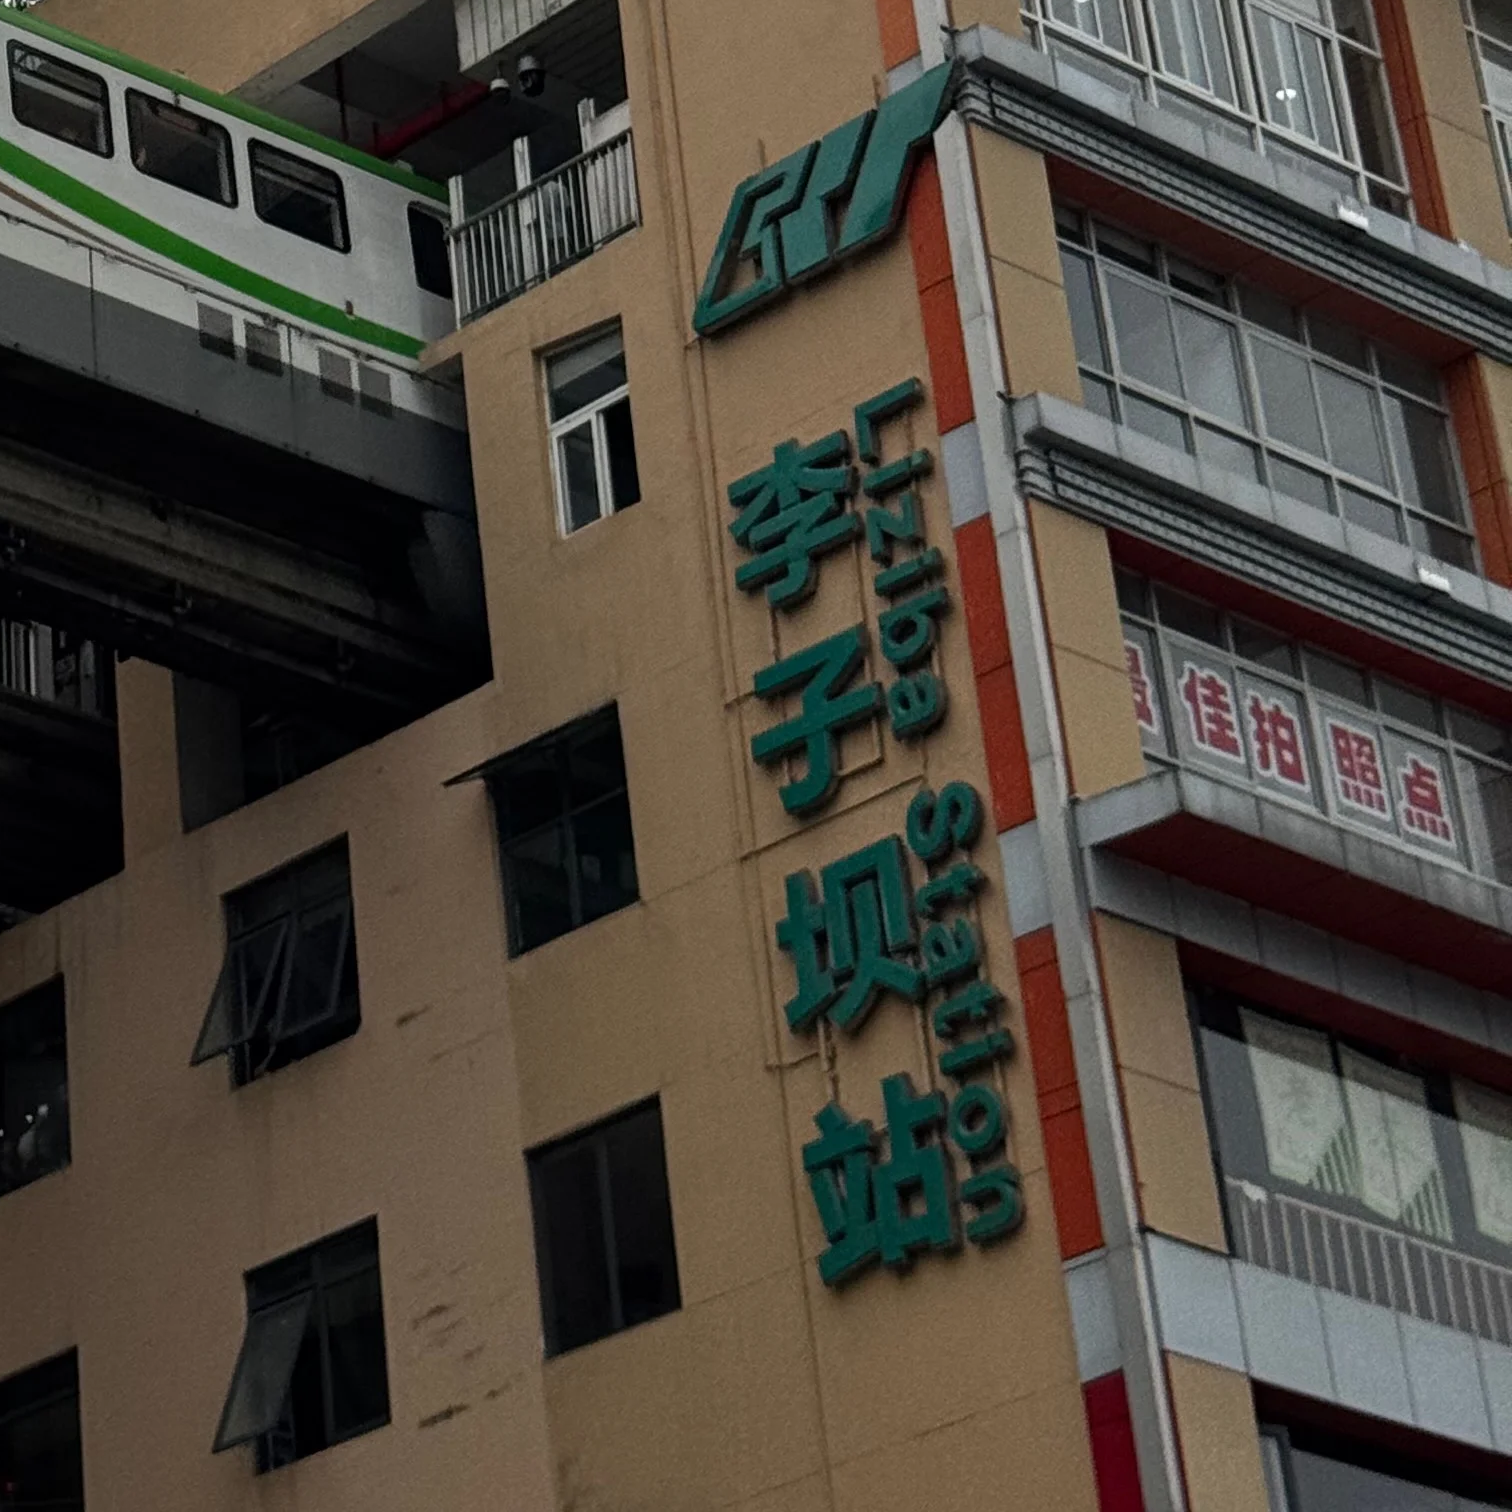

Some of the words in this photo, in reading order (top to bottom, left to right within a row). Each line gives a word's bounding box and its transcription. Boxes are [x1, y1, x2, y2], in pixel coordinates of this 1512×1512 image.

[728, 430, 953, 1285] 李子坝站
[854, 377, 946, 740] Liziba
[906, 781, 1022, 1245] Station
